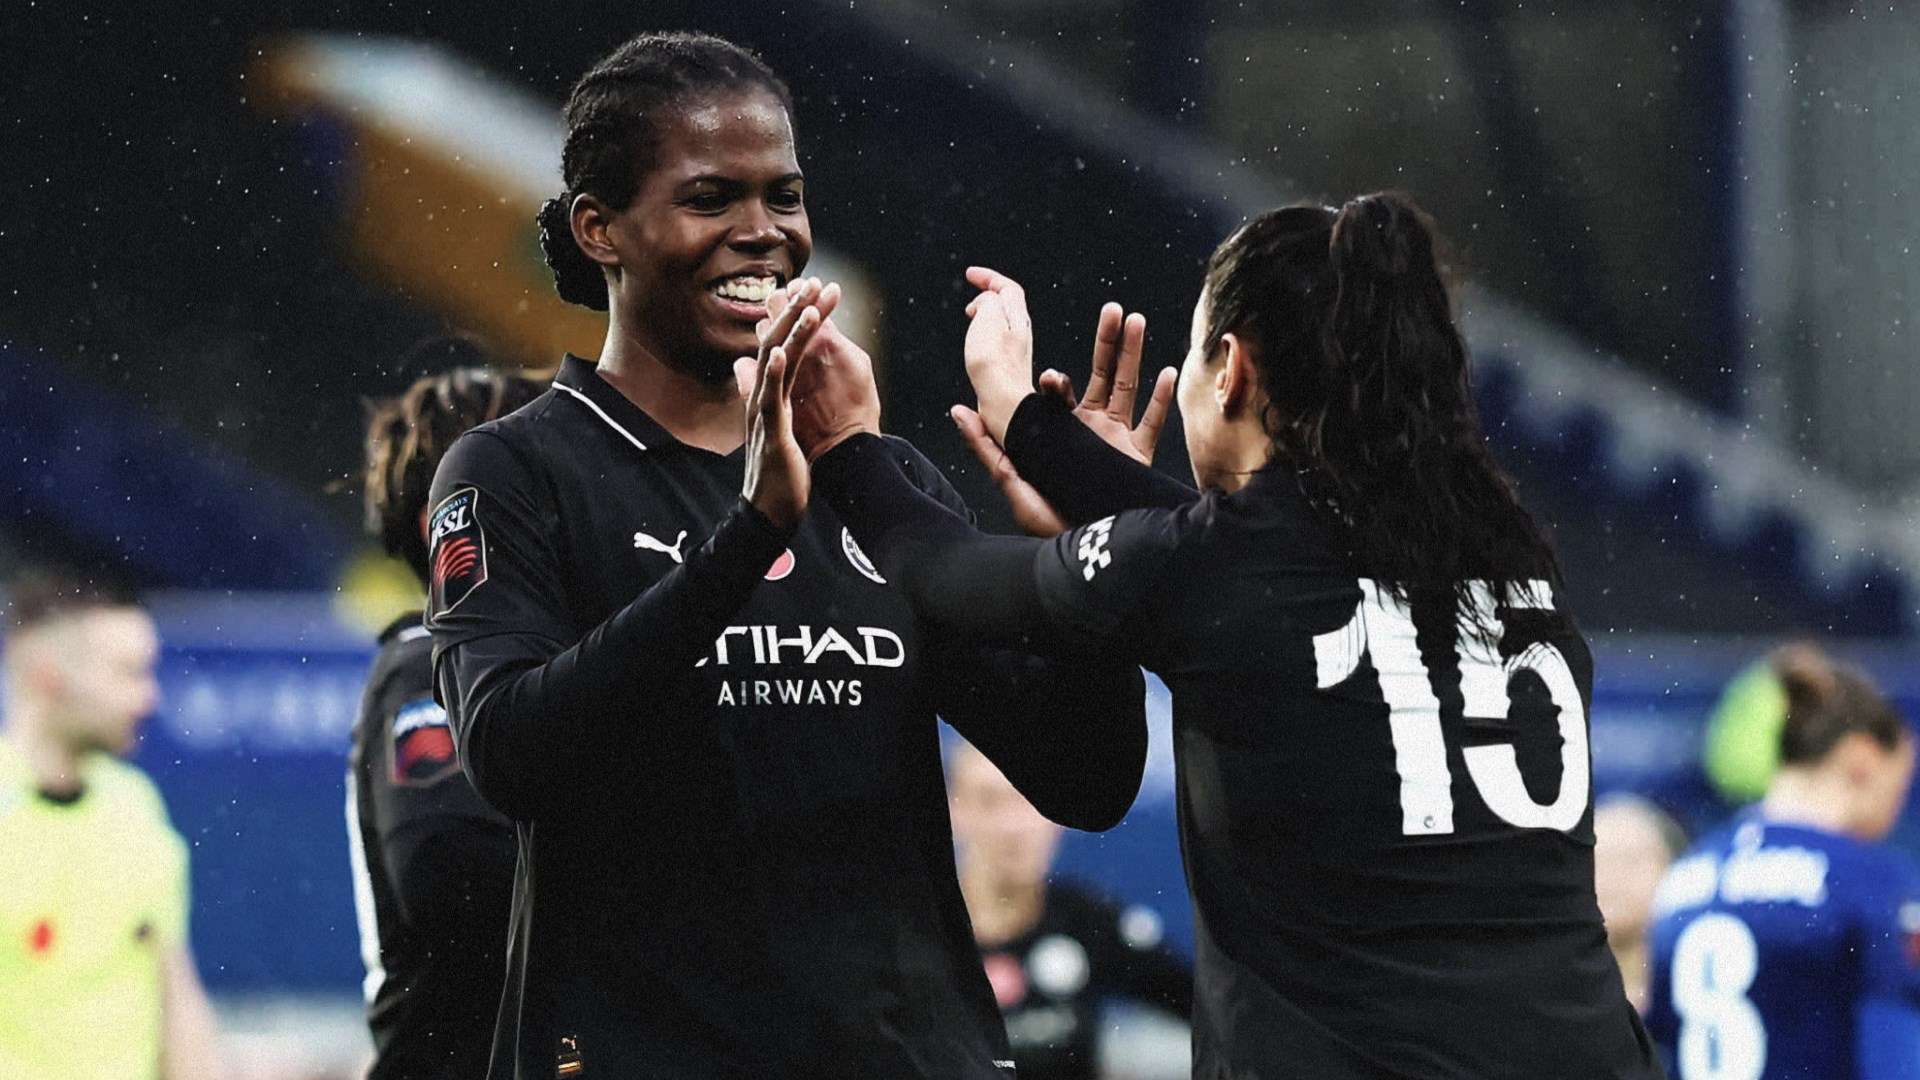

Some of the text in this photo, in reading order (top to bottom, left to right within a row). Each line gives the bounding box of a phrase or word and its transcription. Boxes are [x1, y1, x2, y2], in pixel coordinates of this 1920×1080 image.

[695, 625, 905, 667] TIHAD
[717, 679, 862, 706] AIRWAYS
[1312, 577, 1590, 835] 15
[1671, 912, 1768, 1080] 8
